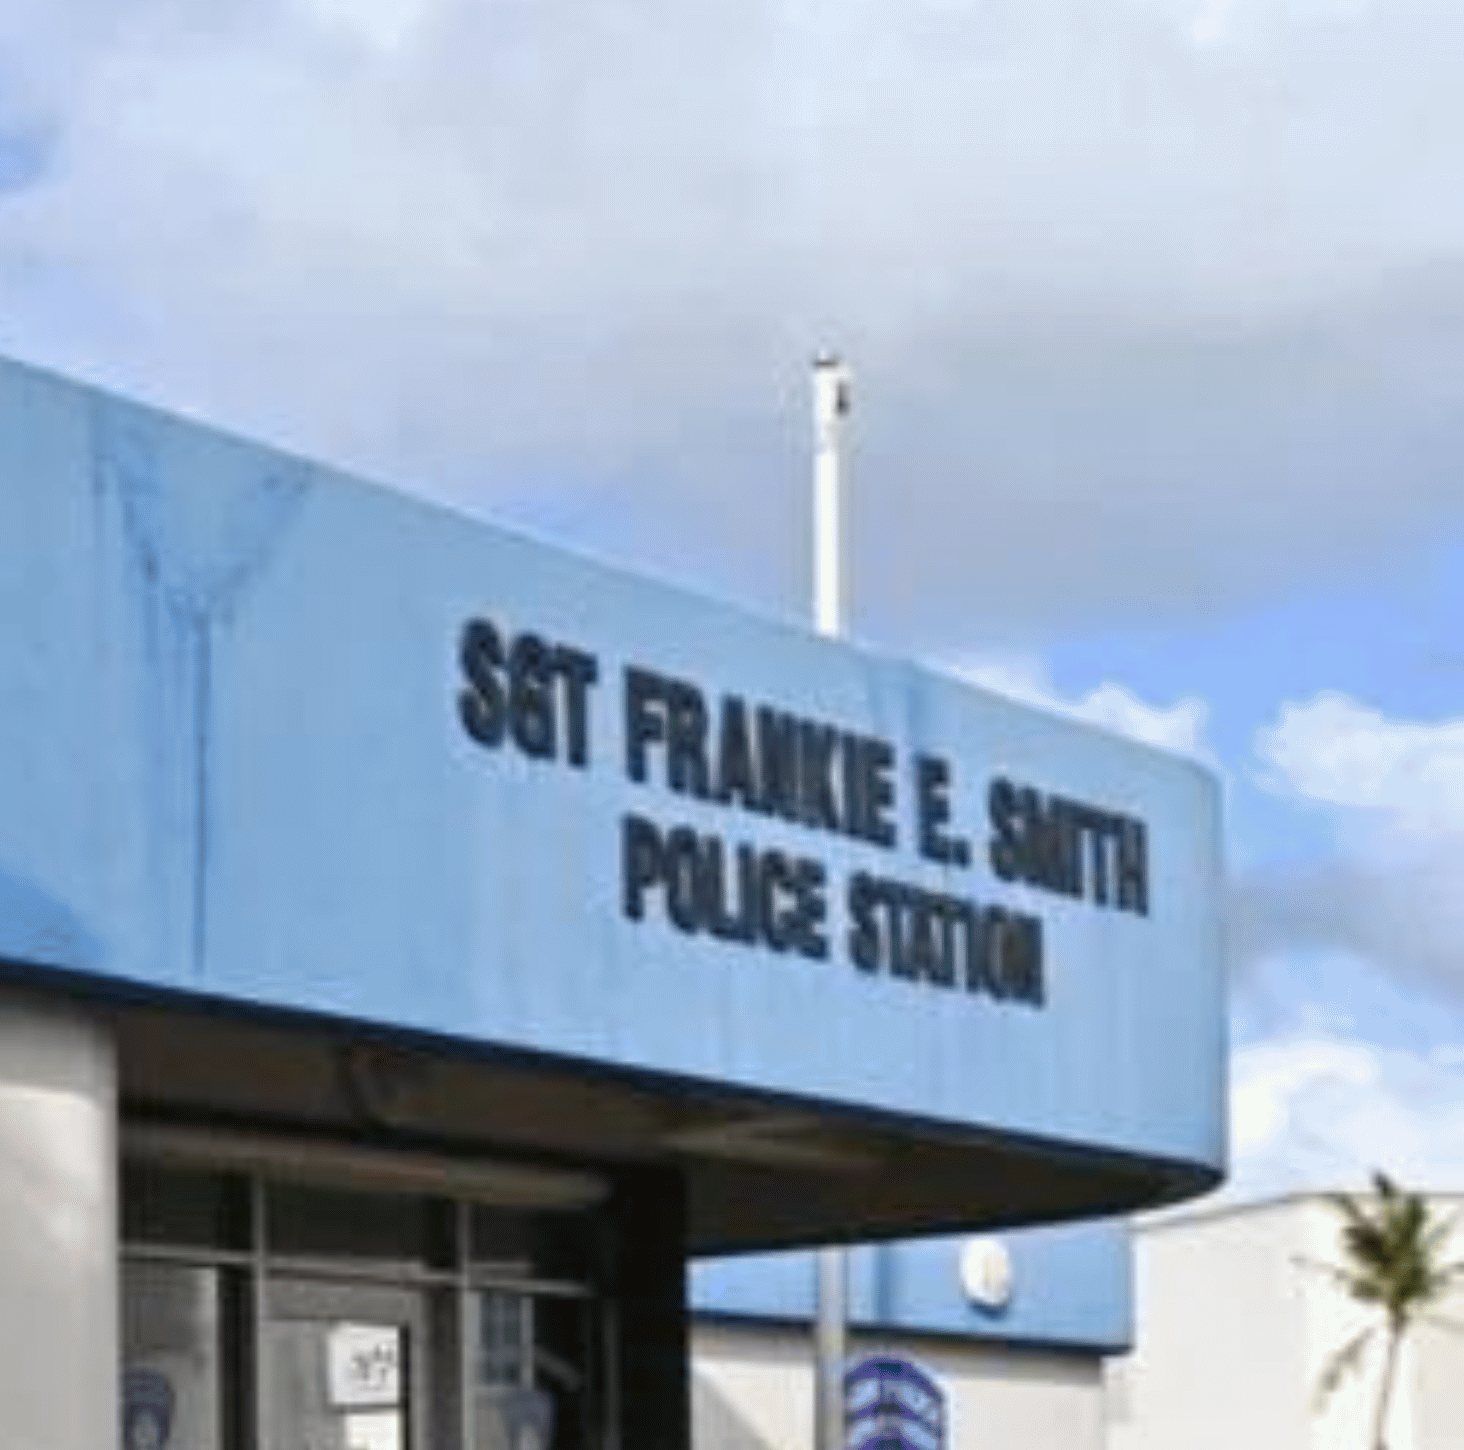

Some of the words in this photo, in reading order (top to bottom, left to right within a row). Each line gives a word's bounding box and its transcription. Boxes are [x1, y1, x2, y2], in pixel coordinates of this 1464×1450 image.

[459, 616, 598, 769] SGT
[623, 664, 897, 849] FRANKIE
[916, 755, 971, 868] E.
[986, 776, 1149, 917] SMITH
[621, 812, 829, 960] POLICE
[848, 870, 1046, 1009] STATION
